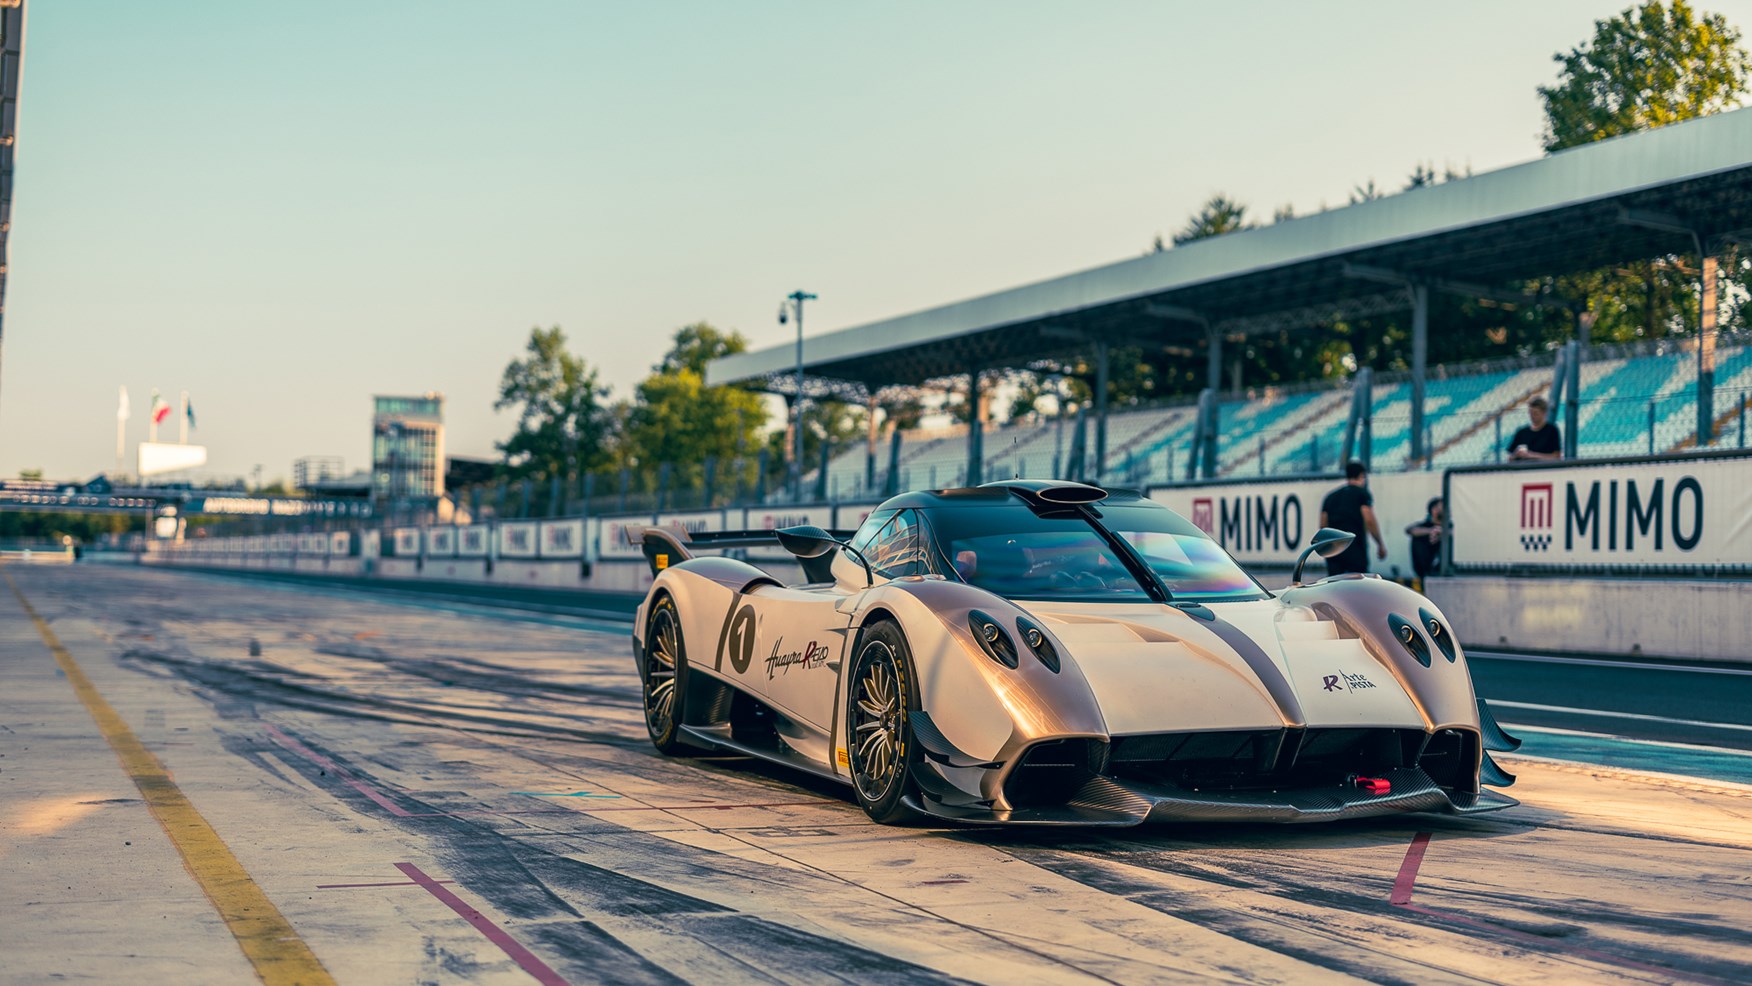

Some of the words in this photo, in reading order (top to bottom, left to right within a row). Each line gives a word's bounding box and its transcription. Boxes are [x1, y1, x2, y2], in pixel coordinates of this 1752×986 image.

[1220, 493, 1303, 552] MIMO
[1565, 475, 1704, 552] MIMO
[737, 617, 748, 660] 1
